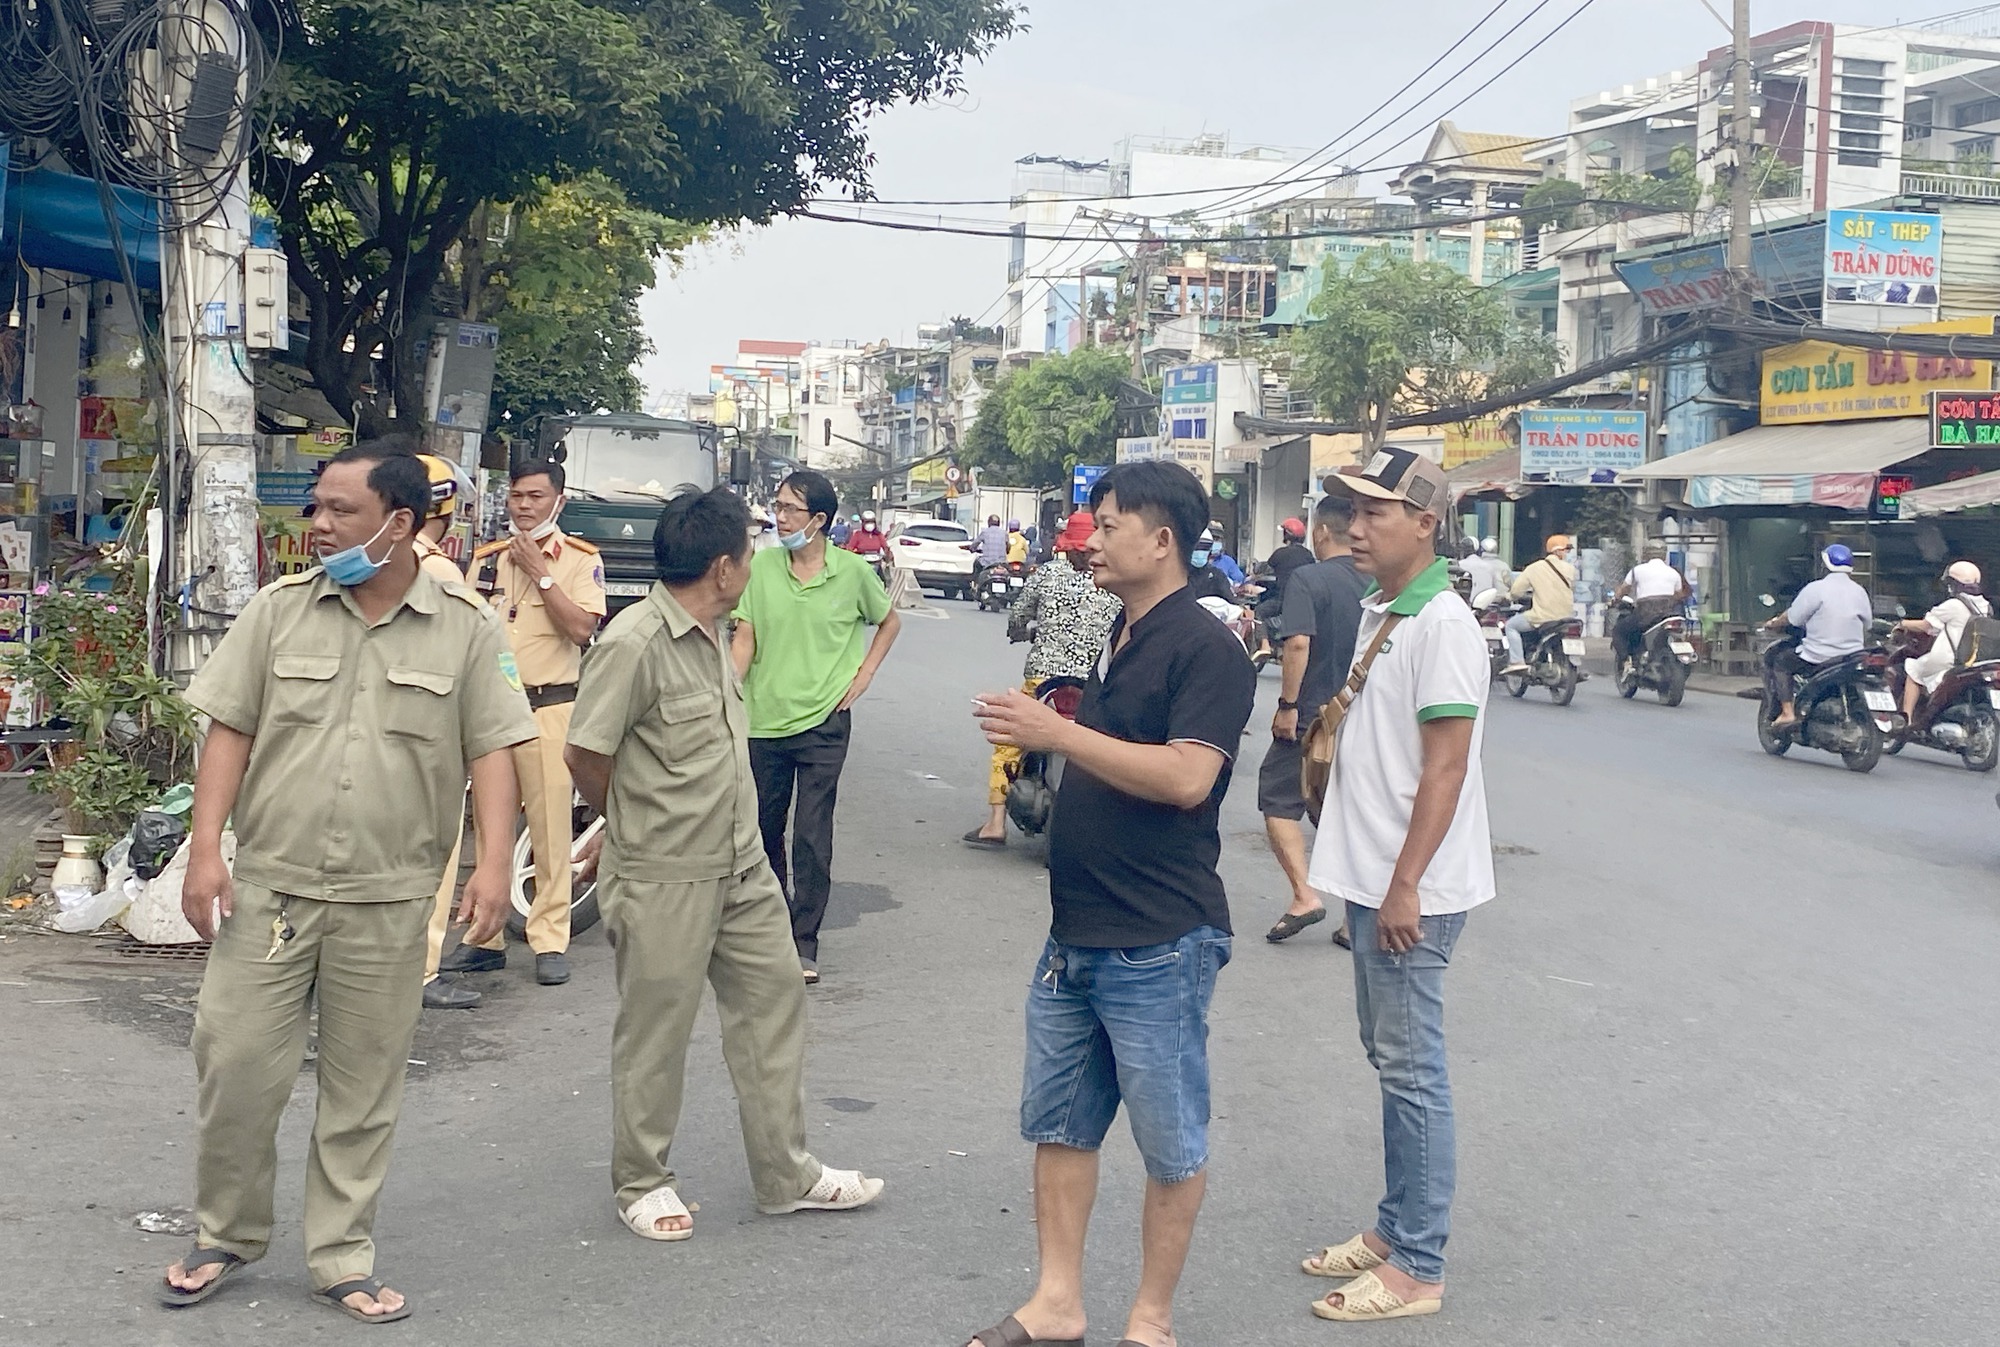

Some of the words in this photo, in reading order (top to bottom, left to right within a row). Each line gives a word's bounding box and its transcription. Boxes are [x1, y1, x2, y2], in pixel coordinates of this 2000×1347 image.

[1843, 214, 1875, 238] SẮT
[1891, 220, 1931, 242] THÉP
[1885, 248, 1934, 277] DŨNG
[1771, 366, 1810, 395] CƠM
[1814, 351, 1854, 391] TẤM
[1939, 397, 1976, 419] CƠM
[1979, 394, 2000, 419] TẤ
[1585, 428, 1639, 447] DŨNG
[1941, 421, 1970, 444] BÀ
[1975, 425, 2000, 444] HA
